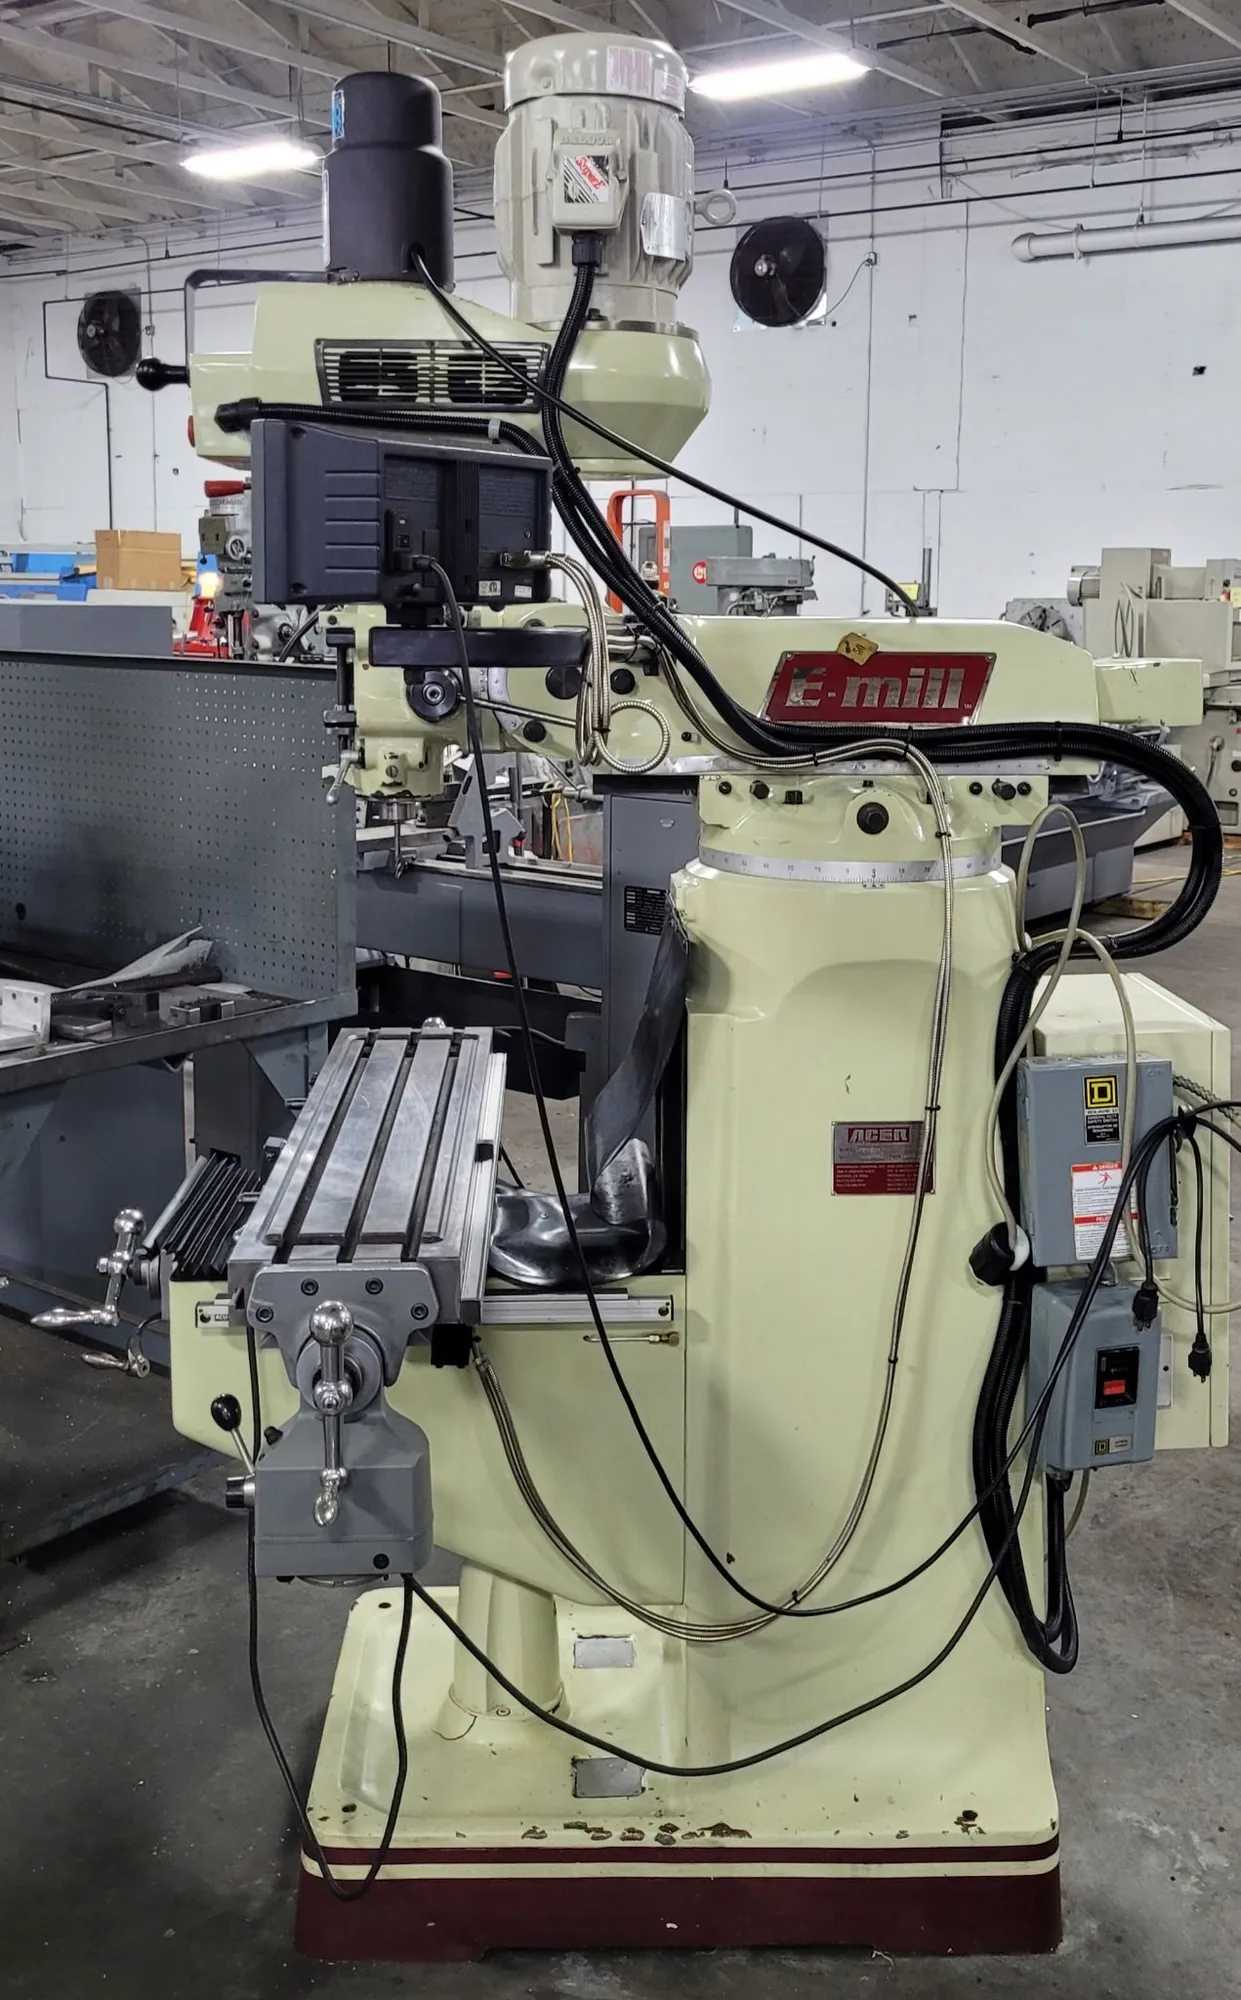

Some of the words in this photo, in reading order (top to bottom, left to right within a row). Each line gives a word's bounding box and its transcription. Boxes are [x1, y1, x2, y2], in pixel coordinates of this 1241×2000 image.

[785, 667, 965, 709] E-mill
[1091, 1082, 1111, 1103] D
[848, 1128, 908, 1143] ACER
